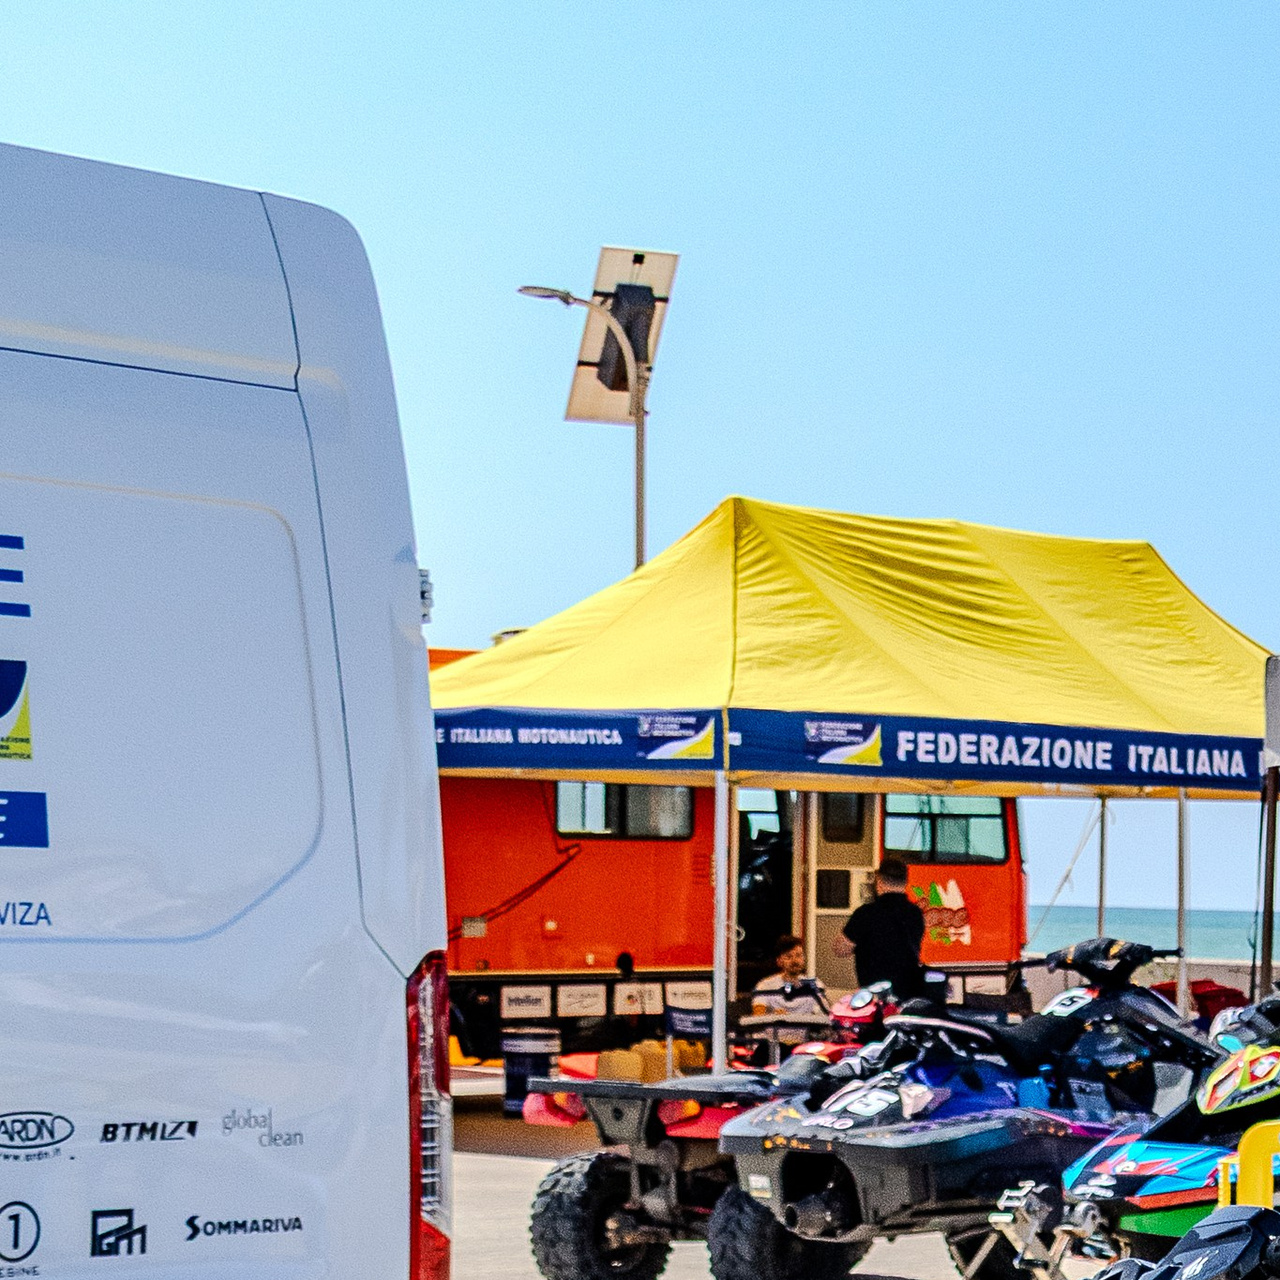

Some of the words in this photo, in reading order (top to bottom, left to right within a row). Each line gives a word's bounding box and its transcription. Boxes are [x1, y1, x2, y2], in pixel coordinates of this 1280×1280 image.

[450, 728, 514, 744] ITALIANA
[517, 728, 623, 745] MOTONAUTICA
[896, 731, 1112, 771] FEDERAZIONE
[1127, 744, 1247, 777] ITALIANA
[222, 1107, 273, 1136] global
[258, 1131, 304, 1148] clean
[186, 1215, 303, 1242] SOMMARIVA
